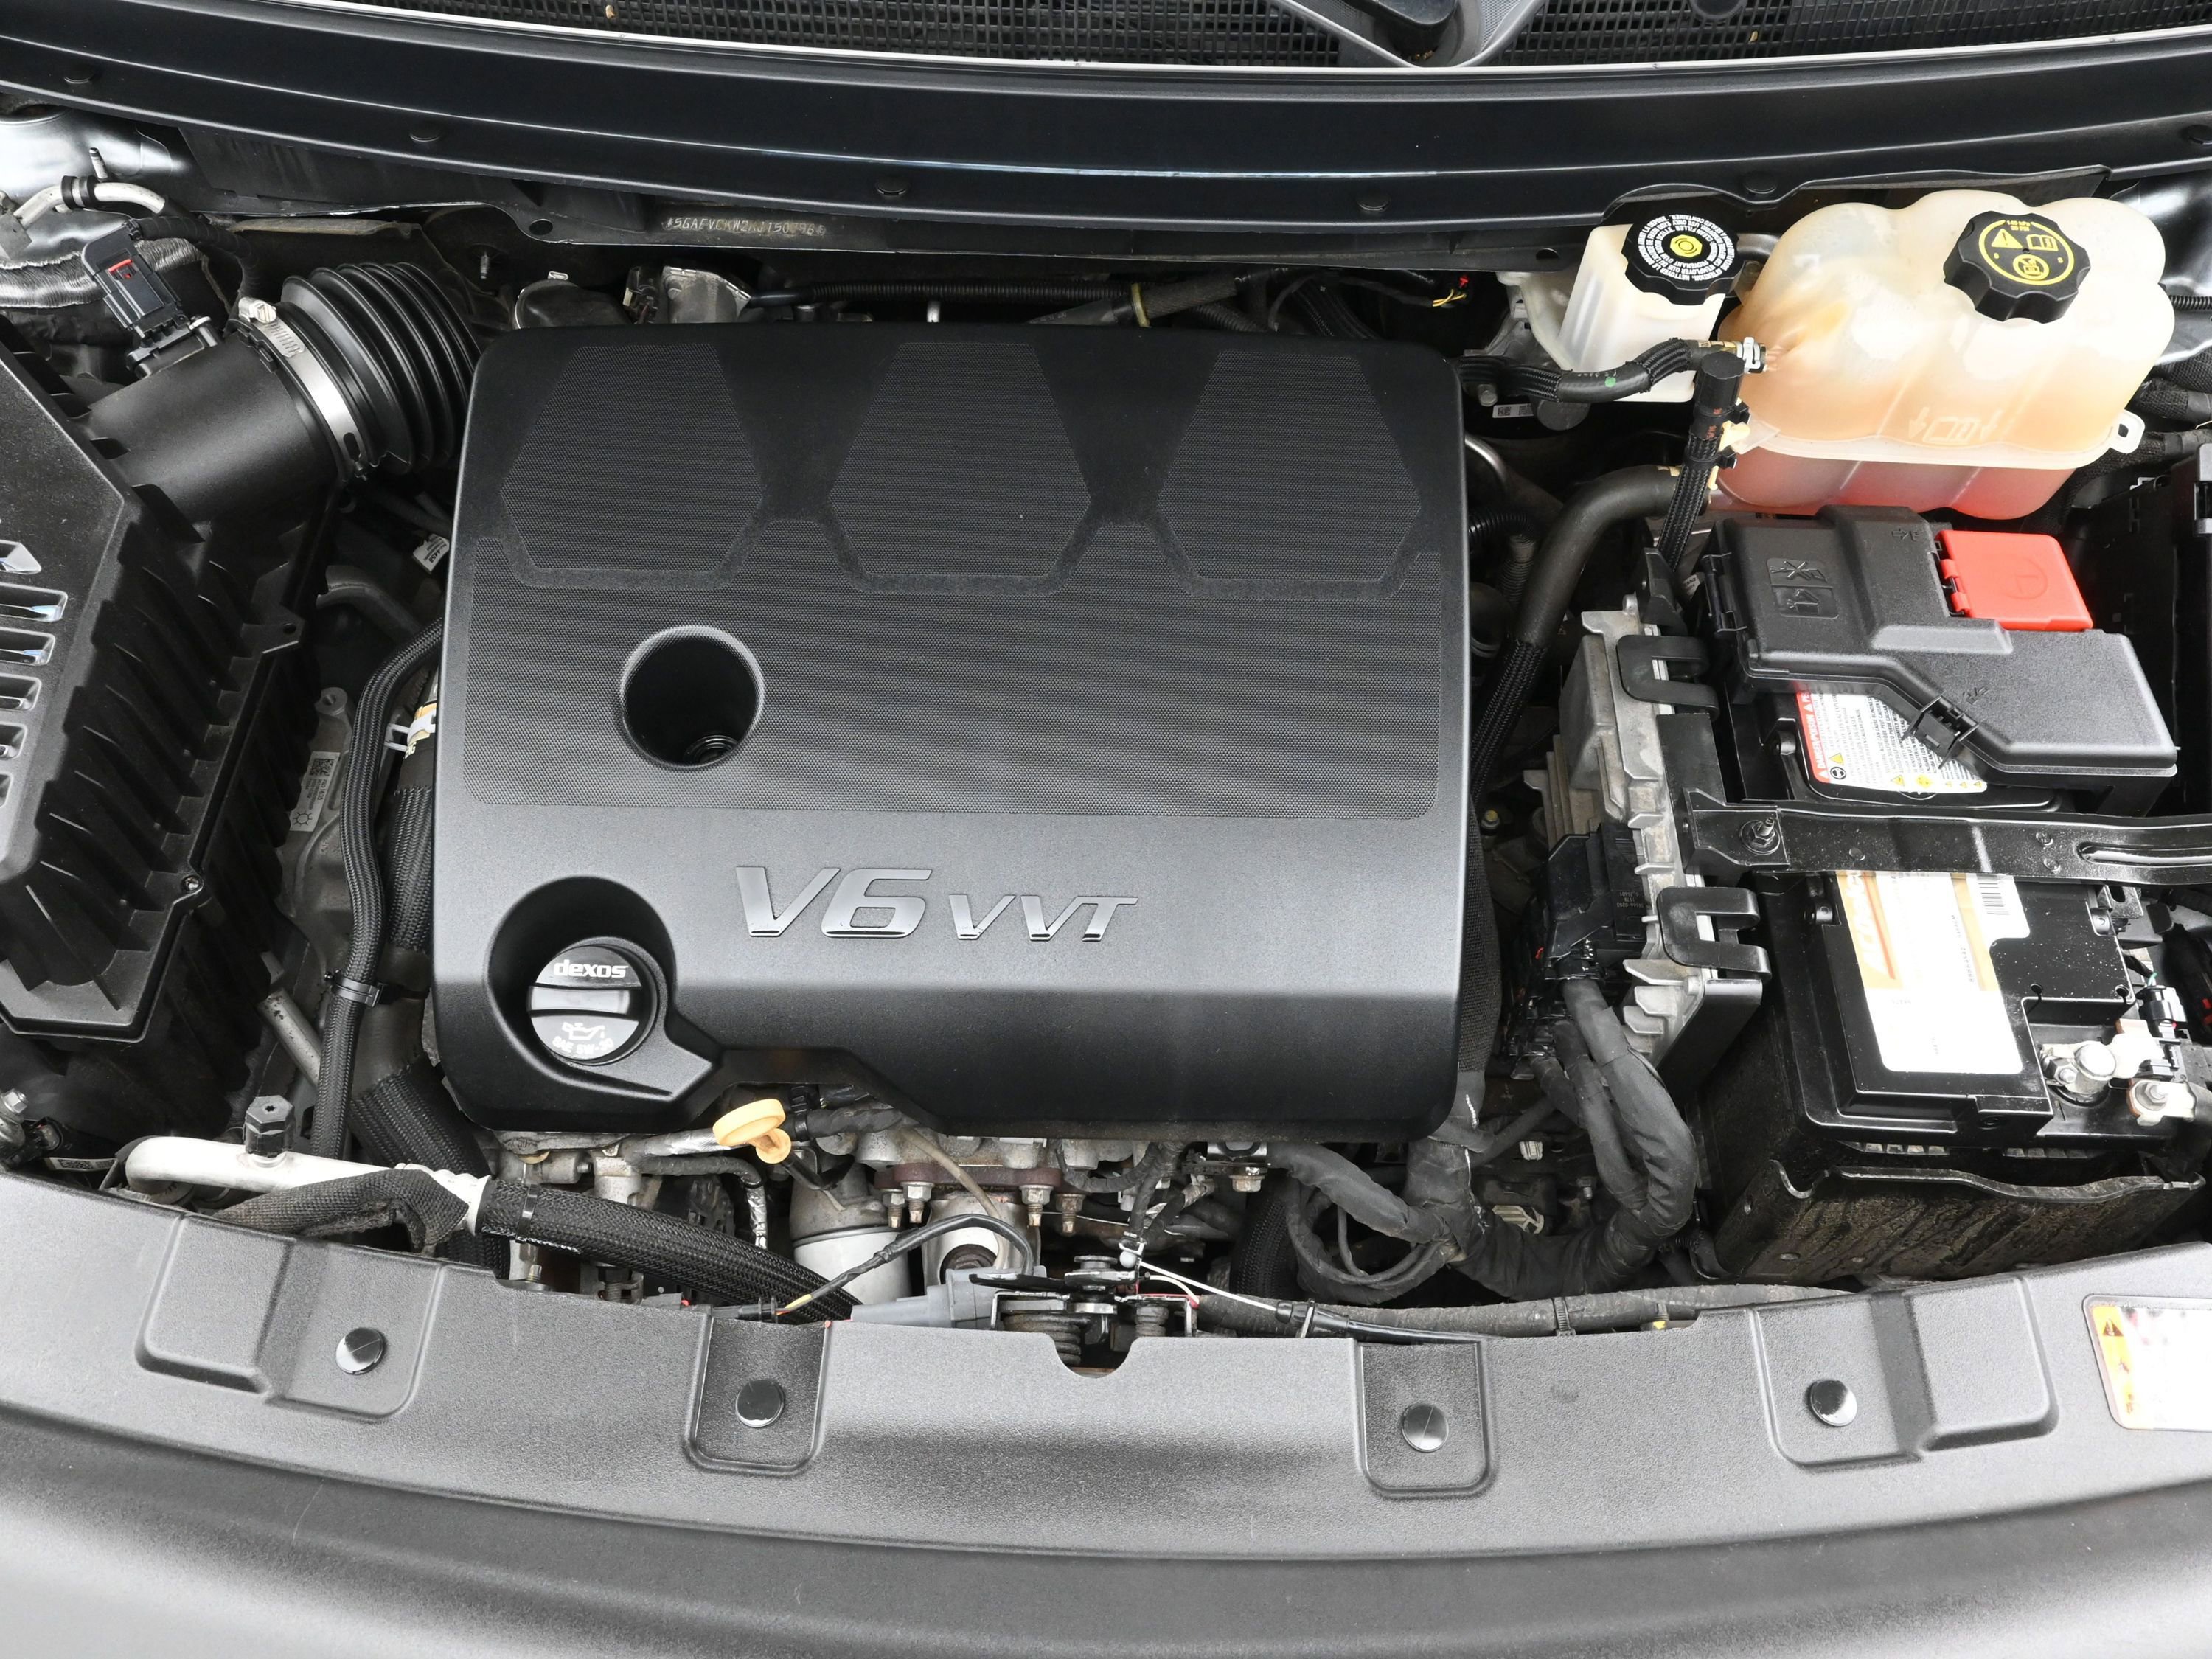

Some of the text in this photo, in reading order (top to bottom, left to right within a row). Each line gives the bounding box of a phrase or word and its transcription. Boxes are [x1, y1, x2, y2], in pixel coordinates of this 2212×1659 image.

[736, 866, 1138, 942] V6 VVT
[554, 959, 628, 978] dexos
